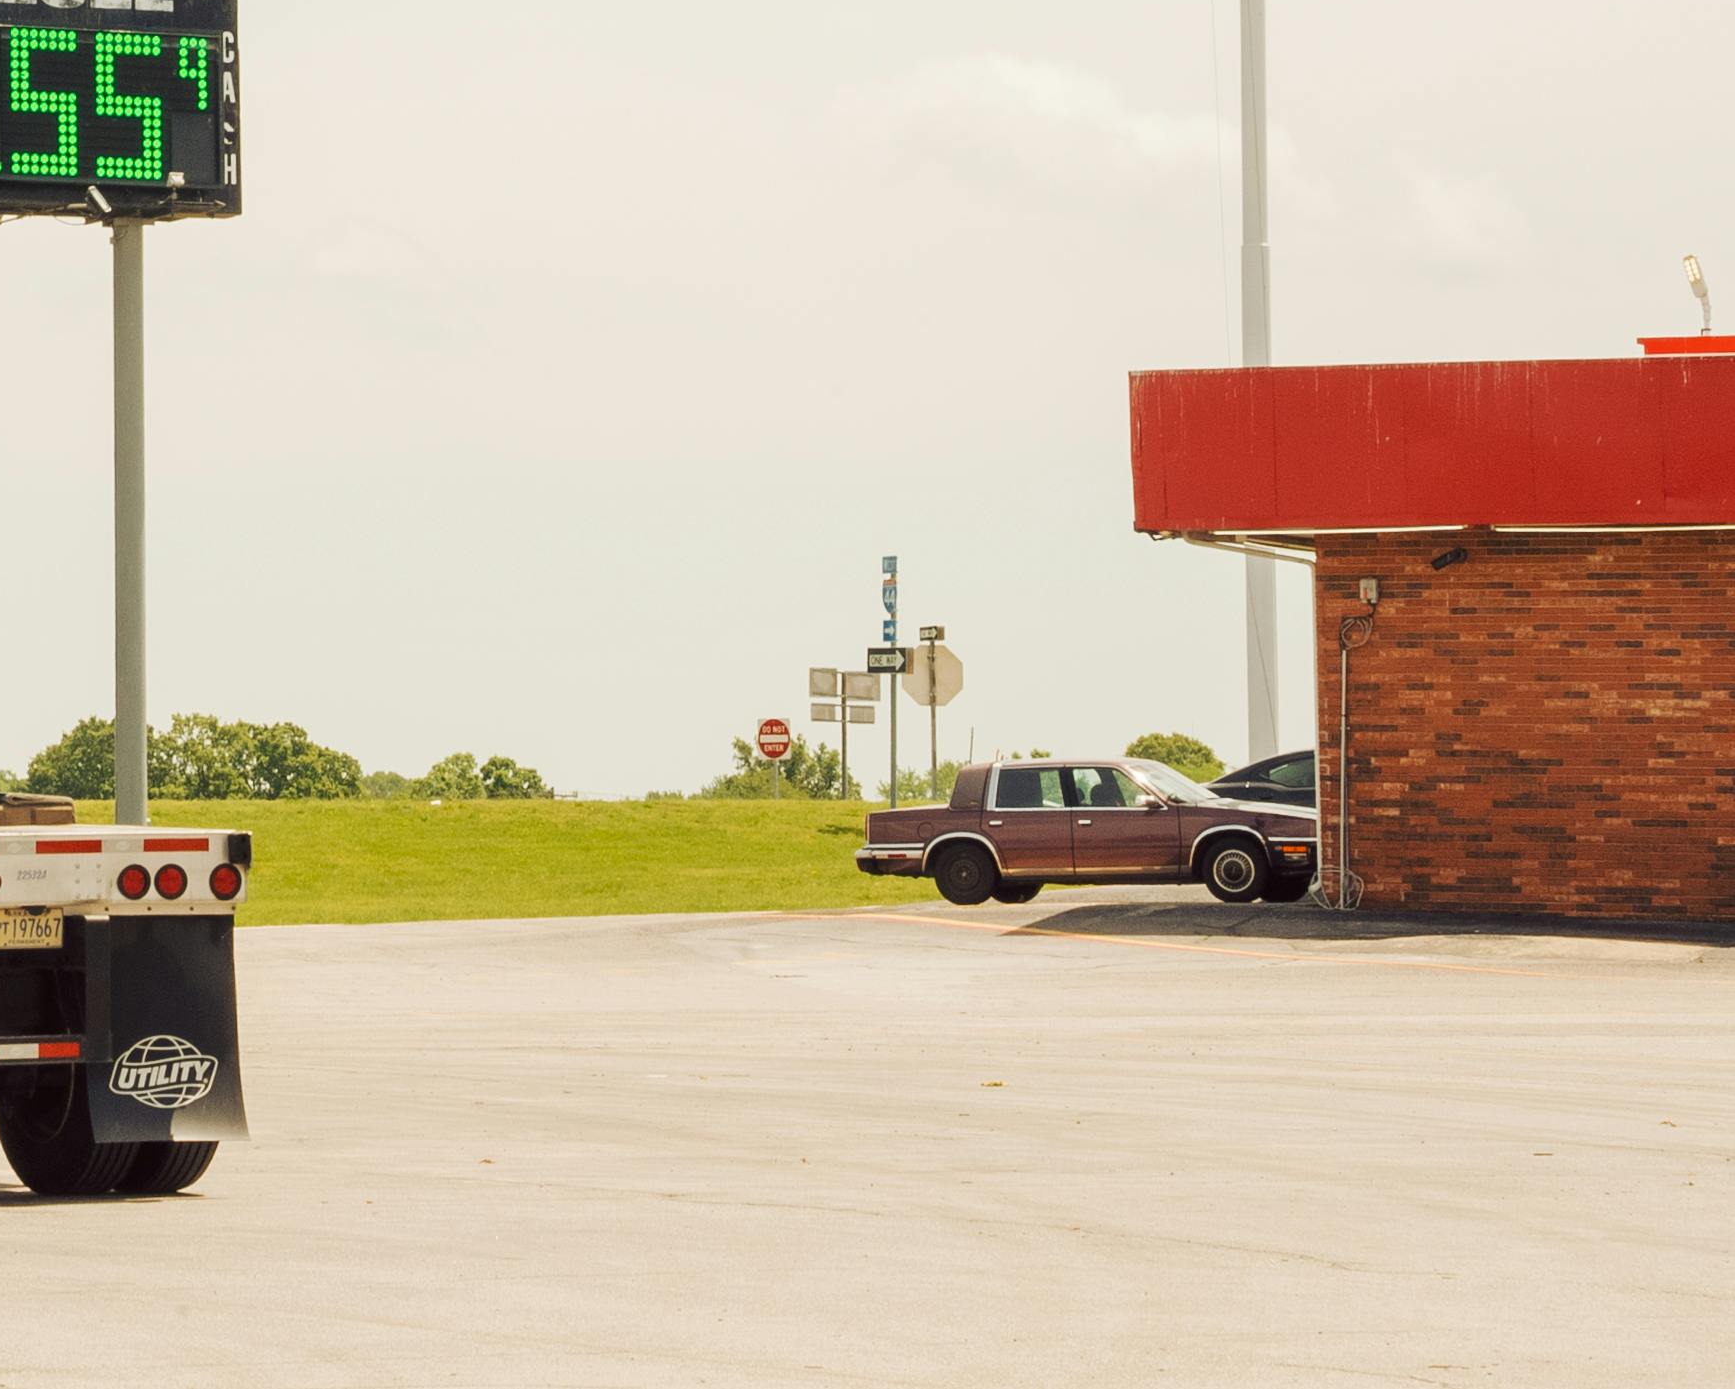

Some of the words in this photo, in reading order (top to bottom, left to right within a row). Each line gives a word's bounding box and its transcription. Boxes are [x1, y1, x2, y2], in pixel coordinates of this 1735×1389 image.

[871, 654, 882, 665] ONE
[762, 725, 771, 733] DO
[773, 725, 785, 733] NOT
[764, 744, 784, 752] ENTER
[118, 1061, 211, 1089] UTILITY
